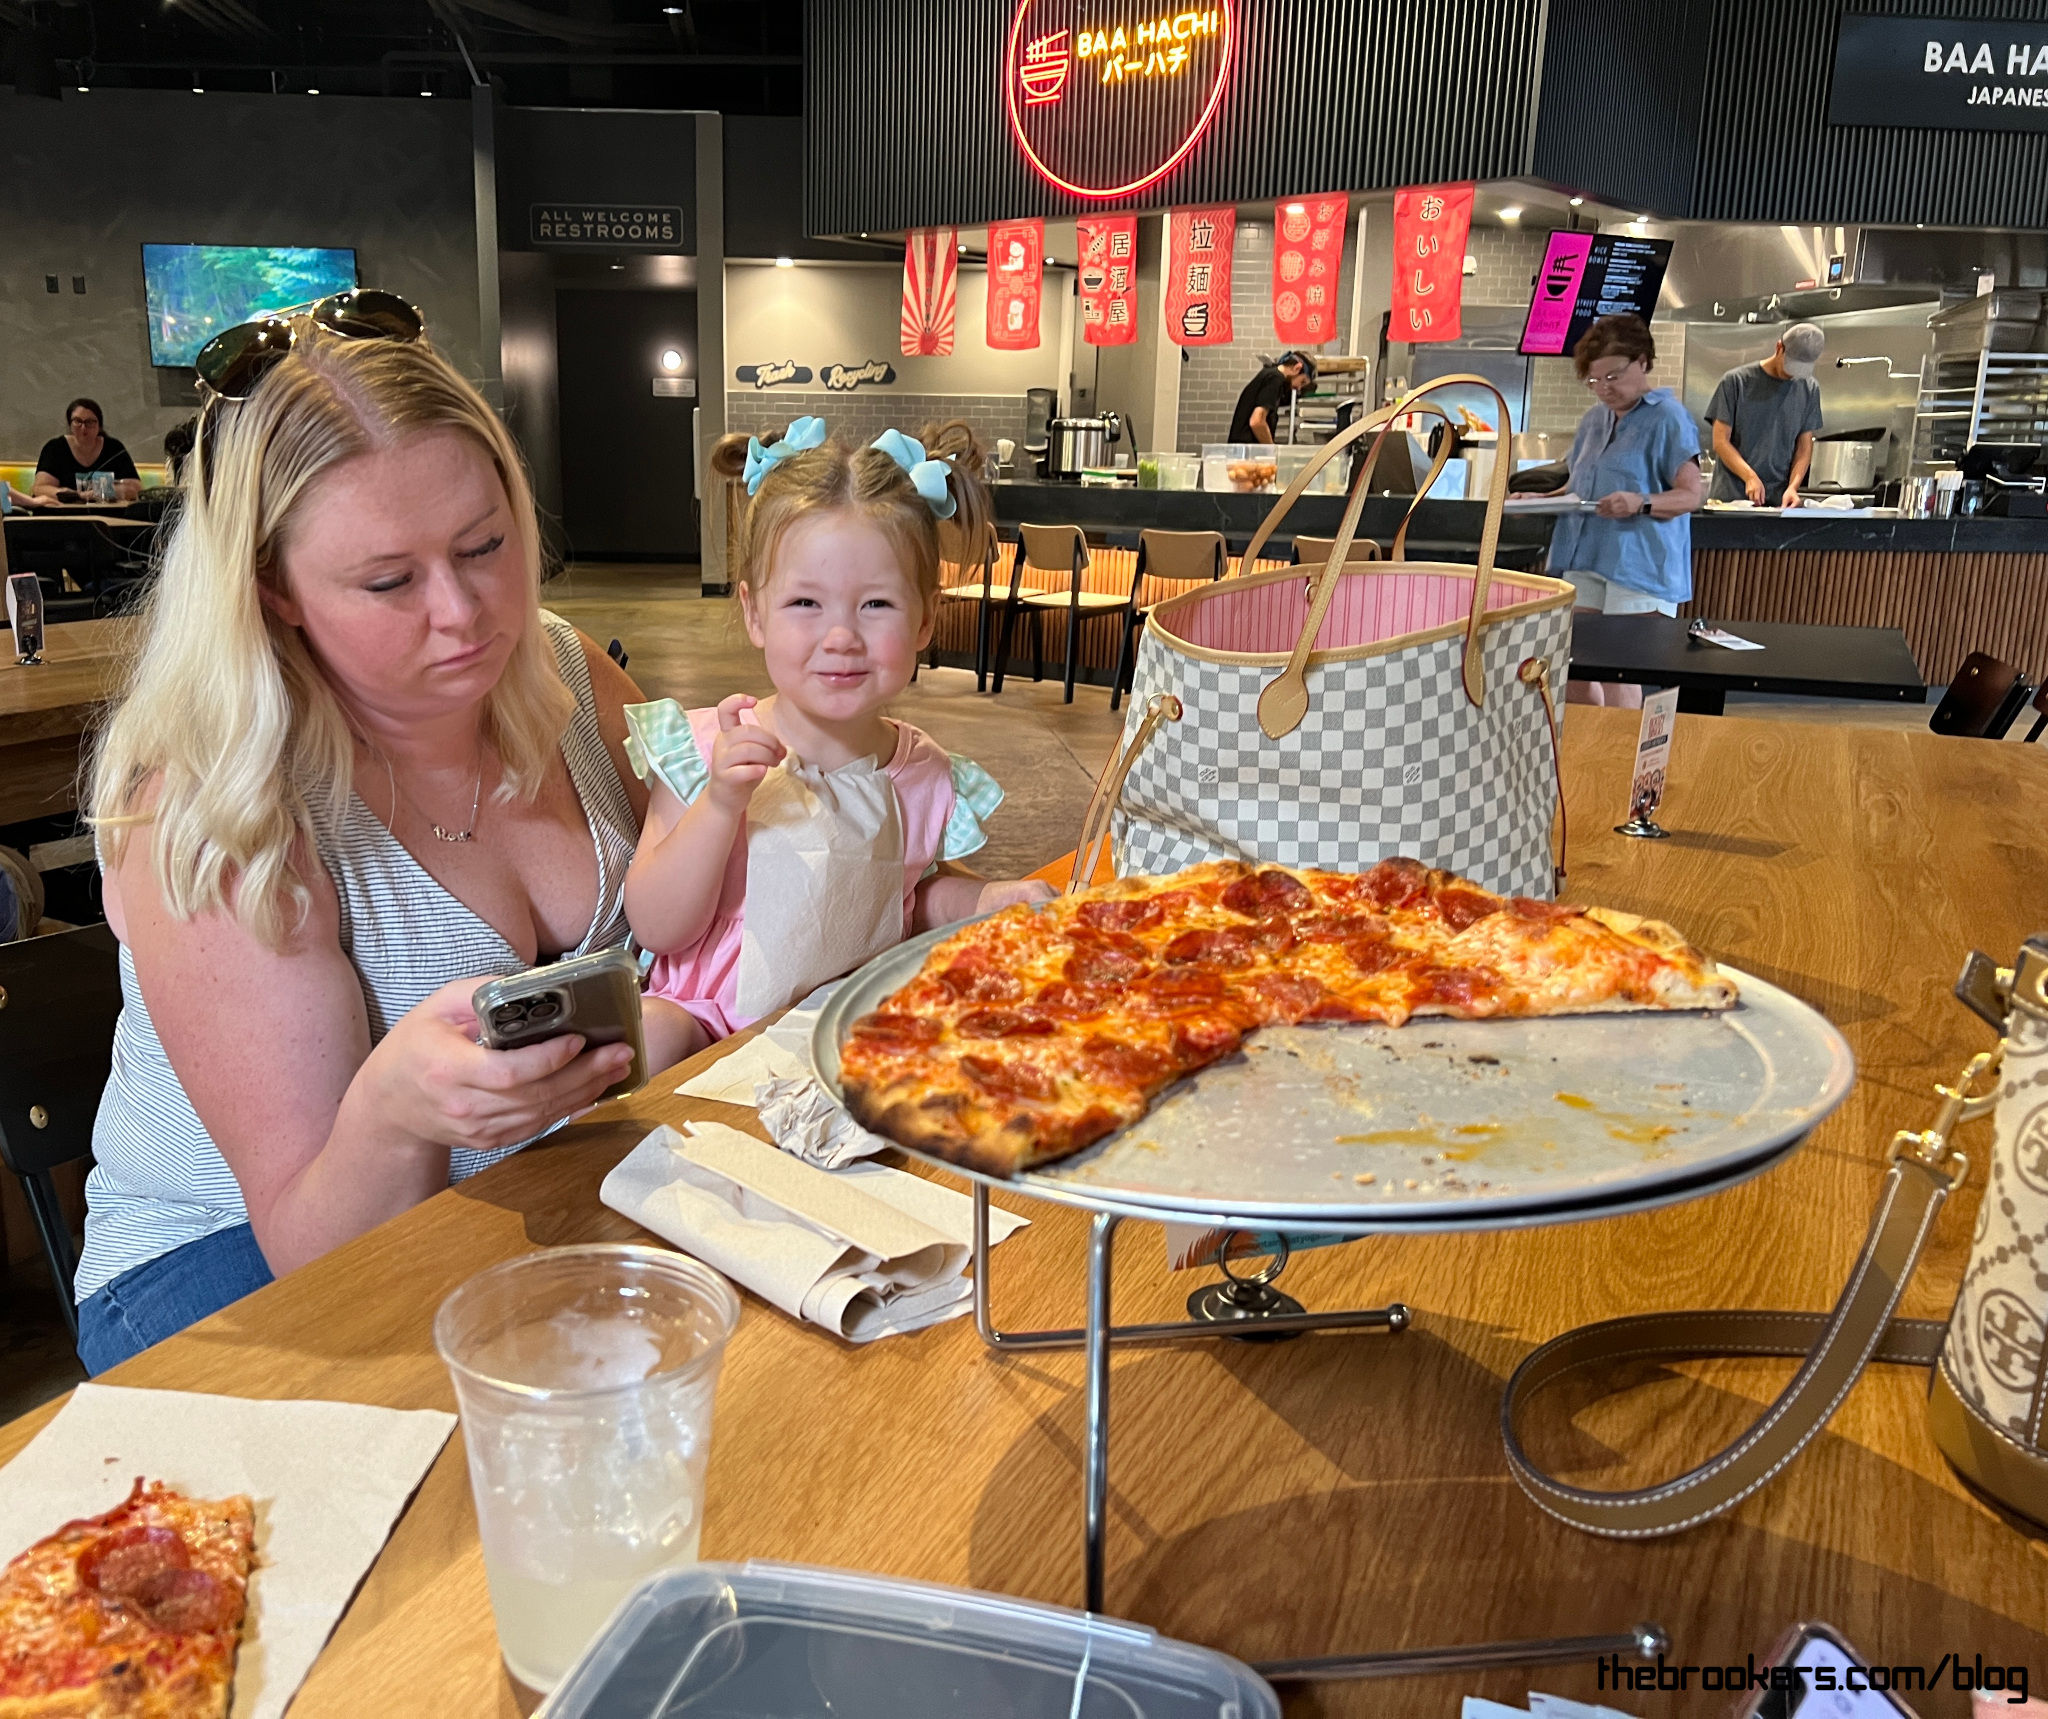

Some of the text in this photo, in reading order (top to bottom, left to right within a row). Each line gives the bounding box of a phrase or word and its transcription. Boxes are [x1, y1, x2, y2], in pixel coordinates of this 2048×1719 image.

[1077, 10, 1218, 58] BAA HACHI
[1923, 41, 1995, 75] BAA
[539, 223, 674, 240] RESTROOMS
[540, 210, 671, 223] ALL WELCOME
[1108, 232, 1131, 324] 居酒屋
[1410, 195, 1444, 330] おいしい
[756, 360, 889, 389] Trash Recycling
